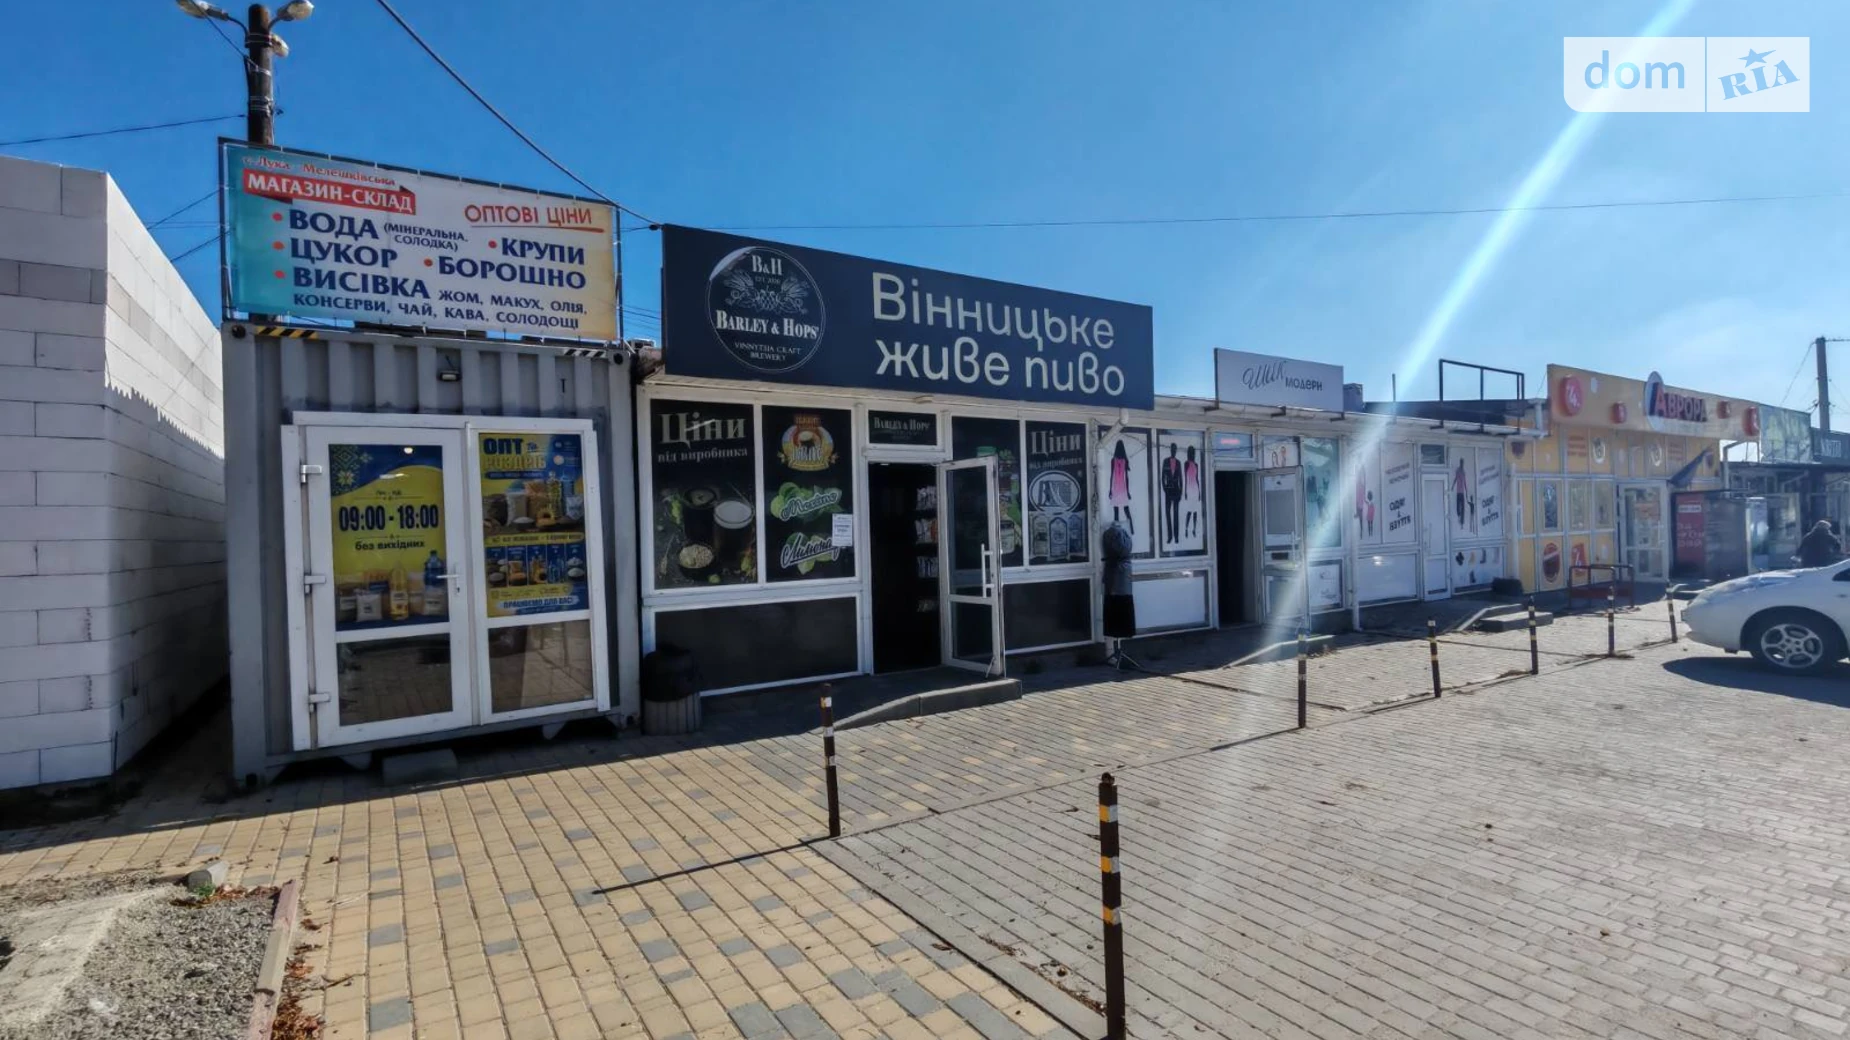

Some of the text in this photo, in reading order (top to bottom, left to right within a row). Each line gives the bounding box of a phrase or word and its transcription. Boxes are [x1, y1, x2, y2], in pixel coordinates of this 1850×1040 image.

[259, 156, 290, 170] Лука
[248, 173, 413, 213] МАГАЗИН-СКЛАД
[290, 209, 379, 241] ВОДА
[464, 204, 592, 227] ОПТОВІ ЦІНИ
[291, 237, 398, 268] ЦУКОР
[394, 234, 458, 252] СОЛОДКА)
[502, 237, 584, 265] КРУПИ
[438, 256, 586, 290] БОРОШНО
[752, 255, 783, 276] B&H
[293, 266, 431, 299] ВИСІВКА
[439, 290, 483, 305] ЖОМ,
[490, 295, 544, 310] МАКУХ,
[294, 293, 391, 315] КОНСЕРВИ,
[398, 302, 437, 318] ЧАЙ,
[496, 312, 579, 329] СОЛОДОЩІ
[716, 309, 769, 334] BARLEY
[771, 322, 780, 335] &
[873, 271, 1115, 352] Вінницьке
[875, 336, 1125, 396] живе пиво
[659, 412, 746, 449] Ціни
[1031, 430, 1081, 456] Ціни
[483, 438, 524, 455] ОПТ
[681, 447, 748, 463] виробника
[339, 505, 385, 531] 09:00
[397, 504, 438, 529] 18:00
[355, 540, 425, 551] без вихідних
